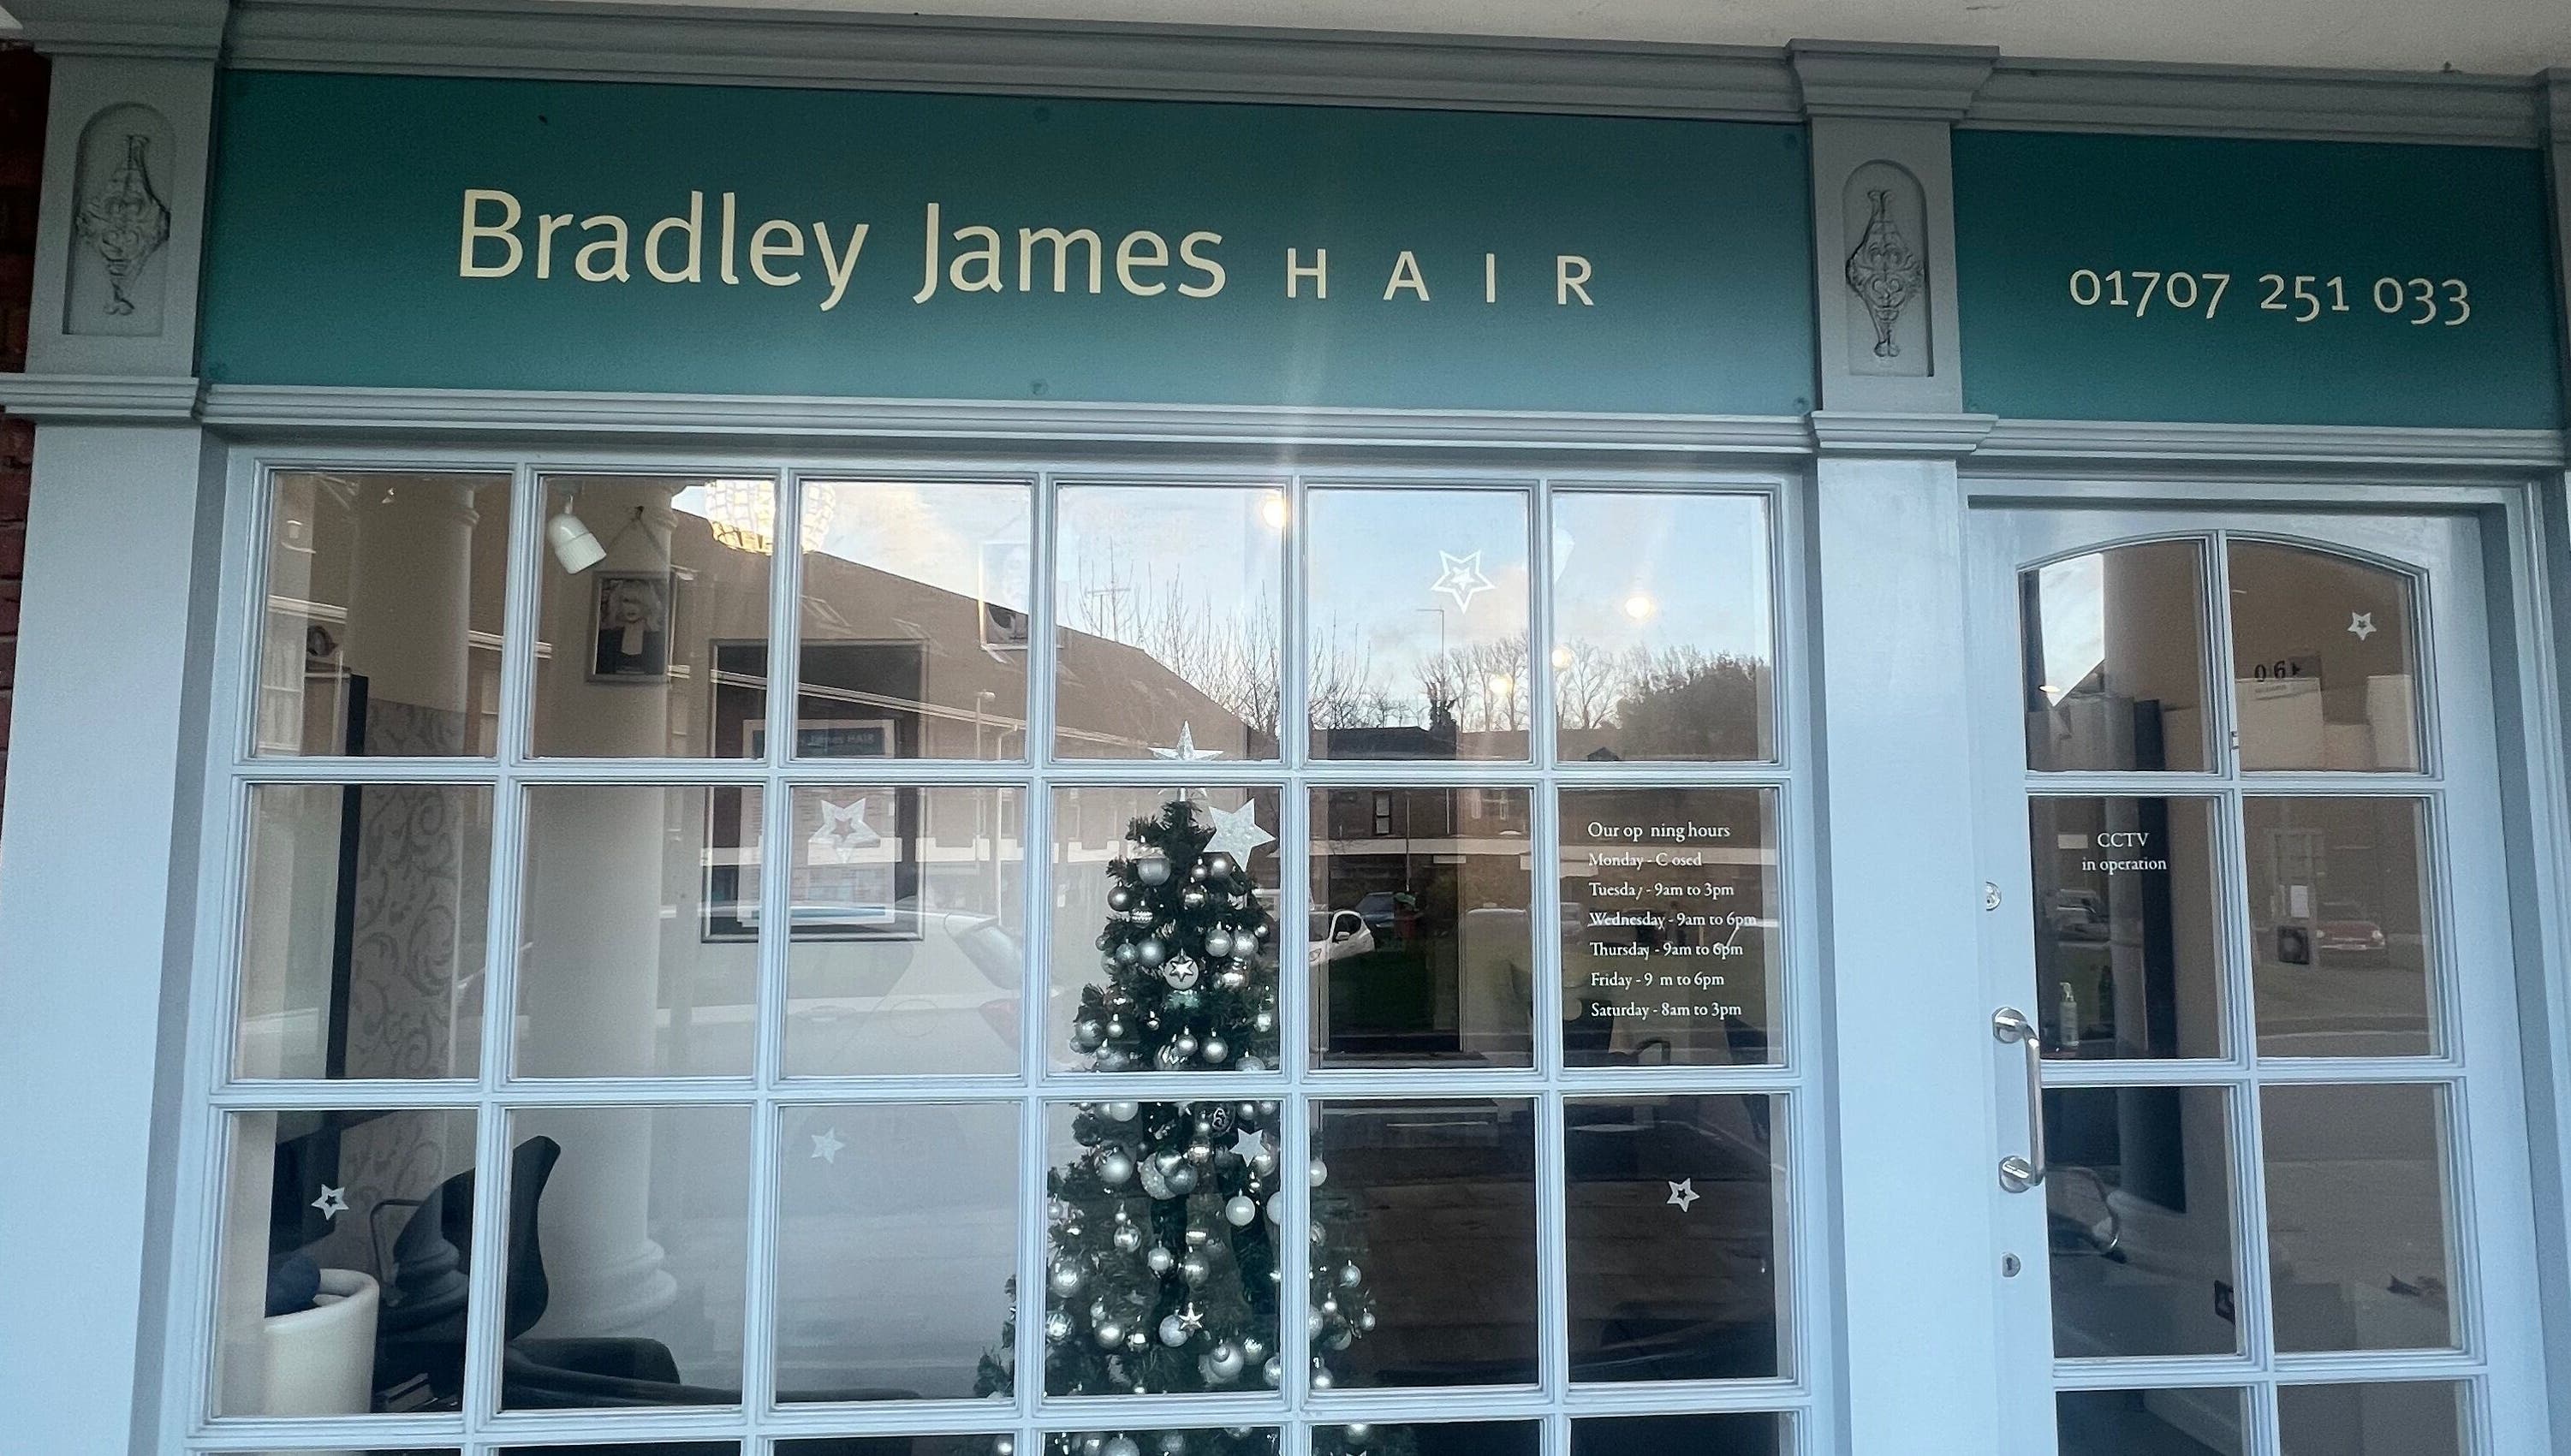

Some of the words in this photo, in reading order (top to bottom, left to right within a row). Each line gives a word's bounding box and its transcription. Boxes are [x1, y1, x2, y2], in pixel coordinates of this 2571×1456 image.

[460, 188, 869, 312] Bradley
[913, 202, 1227, 304] James
[2069, 269, 2230, 318] 01707
[2259, 274, 2350, 323] 251
[2373, 277, 2471, 326] 033
[1587, 822, 1620, 838] Our
[1623, 823, 1685, 842] opning
[1687, 821, 1731, 838] hours
[2097, 832, 2151, 847] CCTV
[1588, 852, 1644, 871] Monday
[1655, 852, 1703, 867] Cosed
[2081, 856, 2097, 871] in
[2099, 857, 2167, 876] operation
[1654, 883, 1683, 898] 9am
[1687, 884, 1701, 896] to
[1704, 883, 1735, 900] 3pm
[1589, 911, 1666, 930] Wednesday
[1676, 912, 1705, 927] 9am
[1709, 914, 1723, 926] to
[1726, 912, 1757, 930] 6pm
[1589, 942, 1650, 960] Thursday
[1663, 942, 1692, 957] 9am
[1695, 944, 1710, 956] to
[1712, 942, 1743, 960] 6pm
[1591, 972, 1633, 990] Friday
[1644, 972, 1673, 987] 9m
[1677, 974, 1691, 986] to
[1693, 972, 1725, 990] 6pm
[1591, 1002, 1650, 1020] Saturday
[1661, 1002, 1691, 1017] 8am
[1693, 1004, 1708, 1016] to
[1711, 1002, 1741, 1020] 3pm
